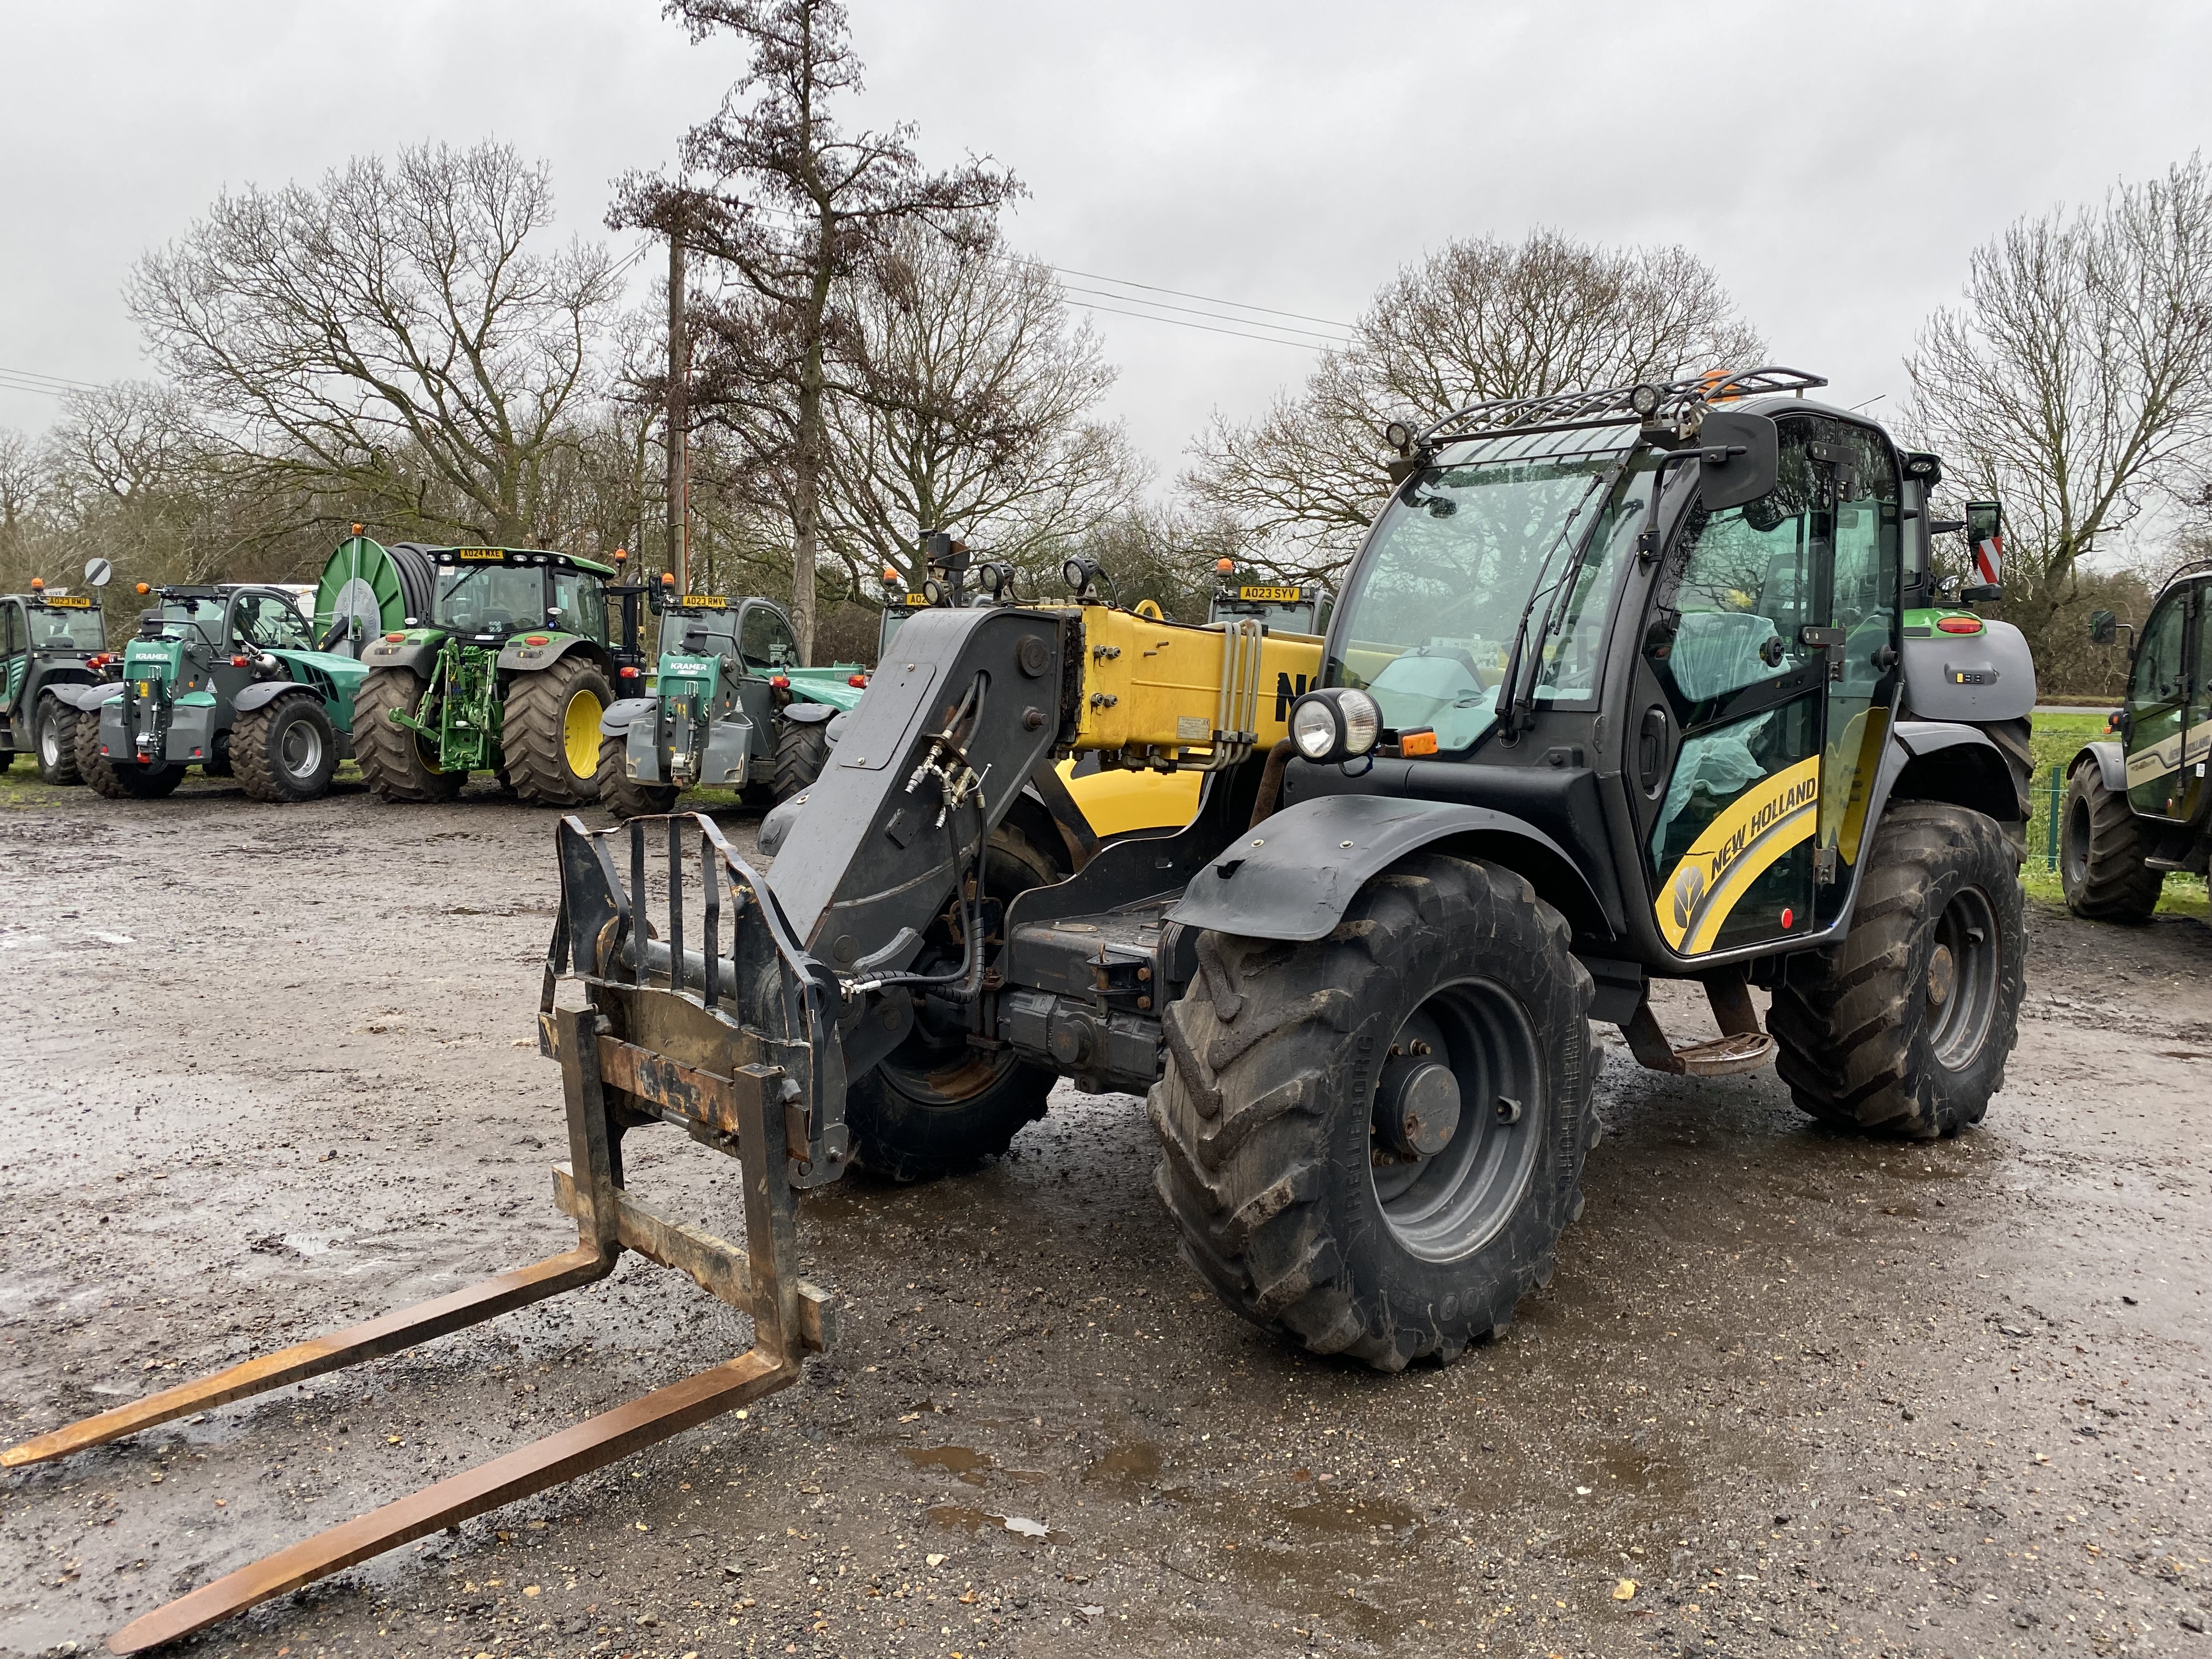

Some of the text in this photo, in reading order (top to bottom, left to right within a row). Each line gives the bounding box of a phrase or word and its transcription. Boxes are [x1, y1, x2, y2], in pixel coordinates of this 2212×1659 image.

[486, 549, 500, 557] MXE
[1245, 588, 1295, 599] AO23 SYV
[686, 597, 707, 605] AO23
[670, 662, 707, 670] KRAMER
[1711, 777, 1816, 882] NEW HOLLAND
